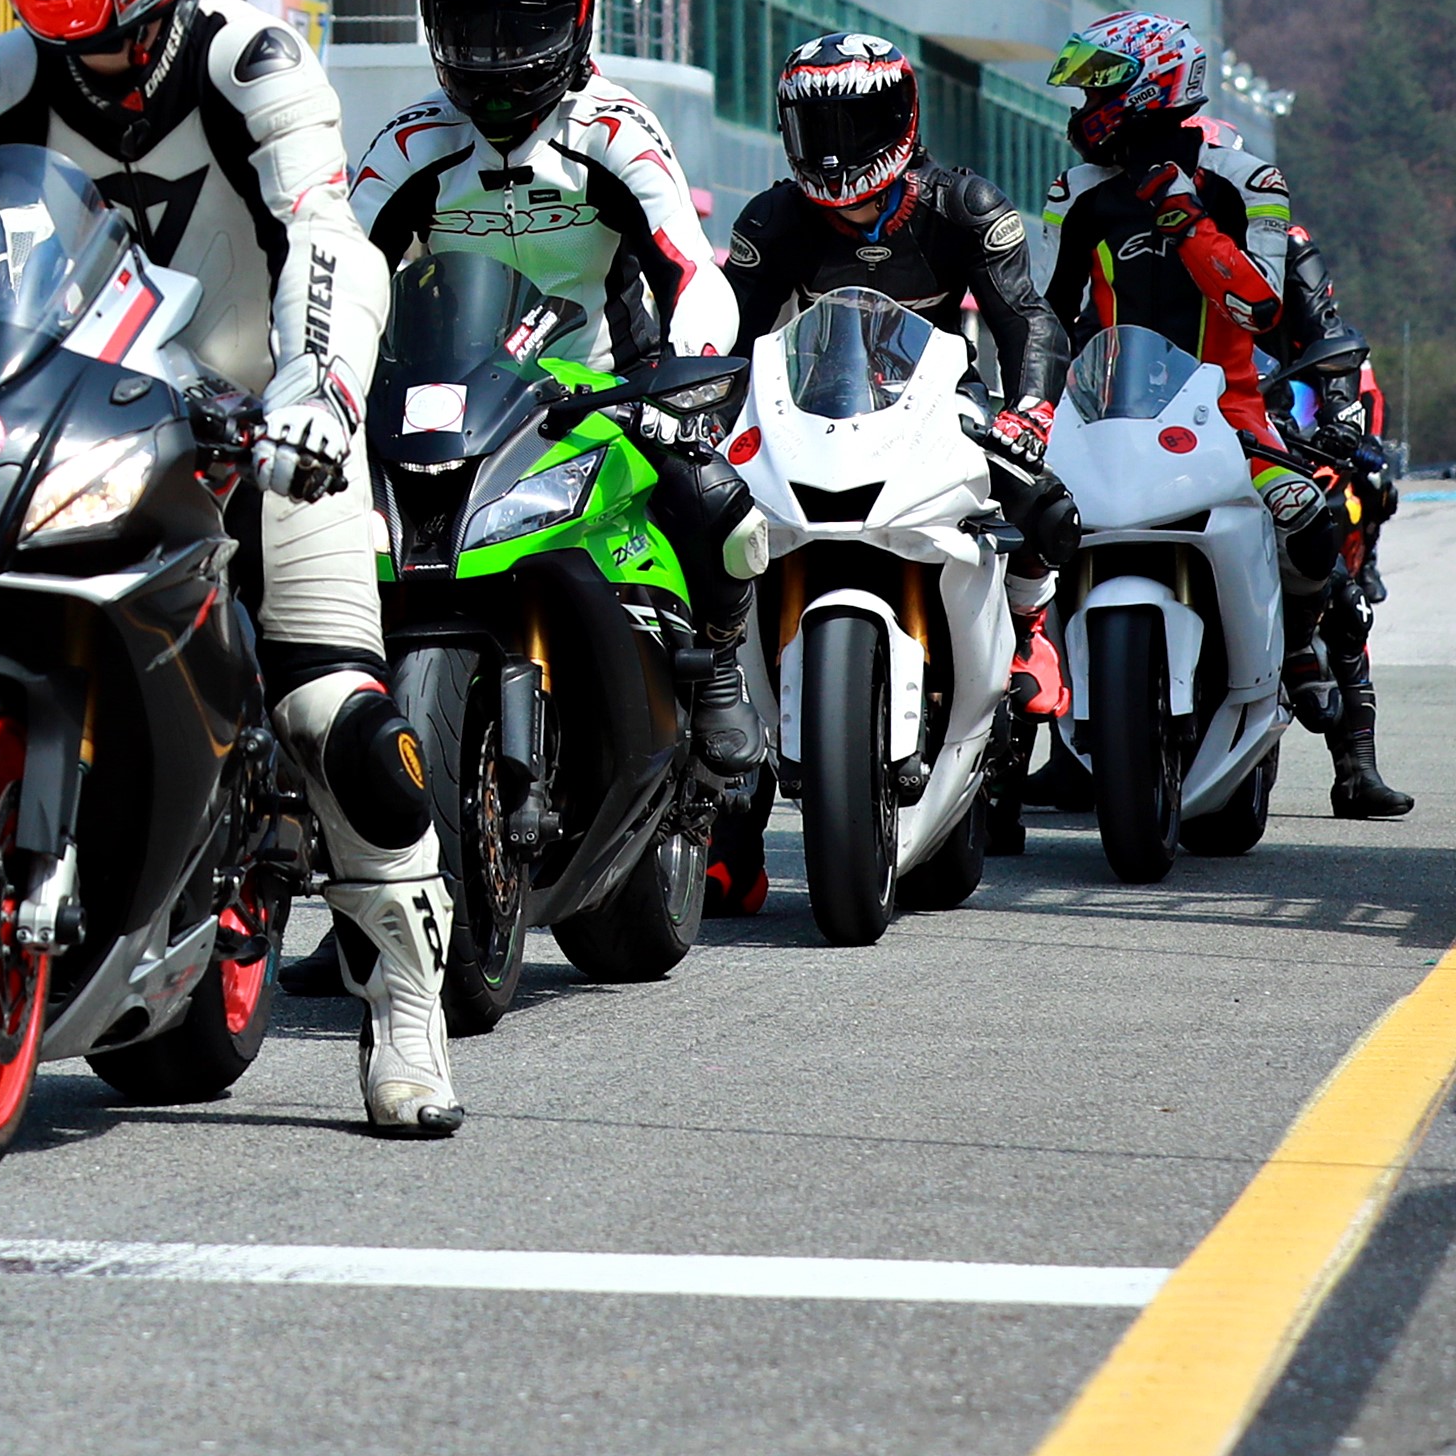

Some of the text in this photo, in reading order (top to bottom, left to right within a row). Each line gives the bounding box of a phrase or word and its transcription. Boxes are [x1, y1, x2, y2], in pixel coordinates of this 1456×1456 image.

[145, 15, 185, 98] DAINESE
[1128, 87, 1157, 107] SHOEI
[429, 205, 600, 236] SPIDI
[506, 326, 530, 354] BIKE
[515, 310, 558, 362] PLAYGROUND
[1164, 431, 1193, 449] B-1
